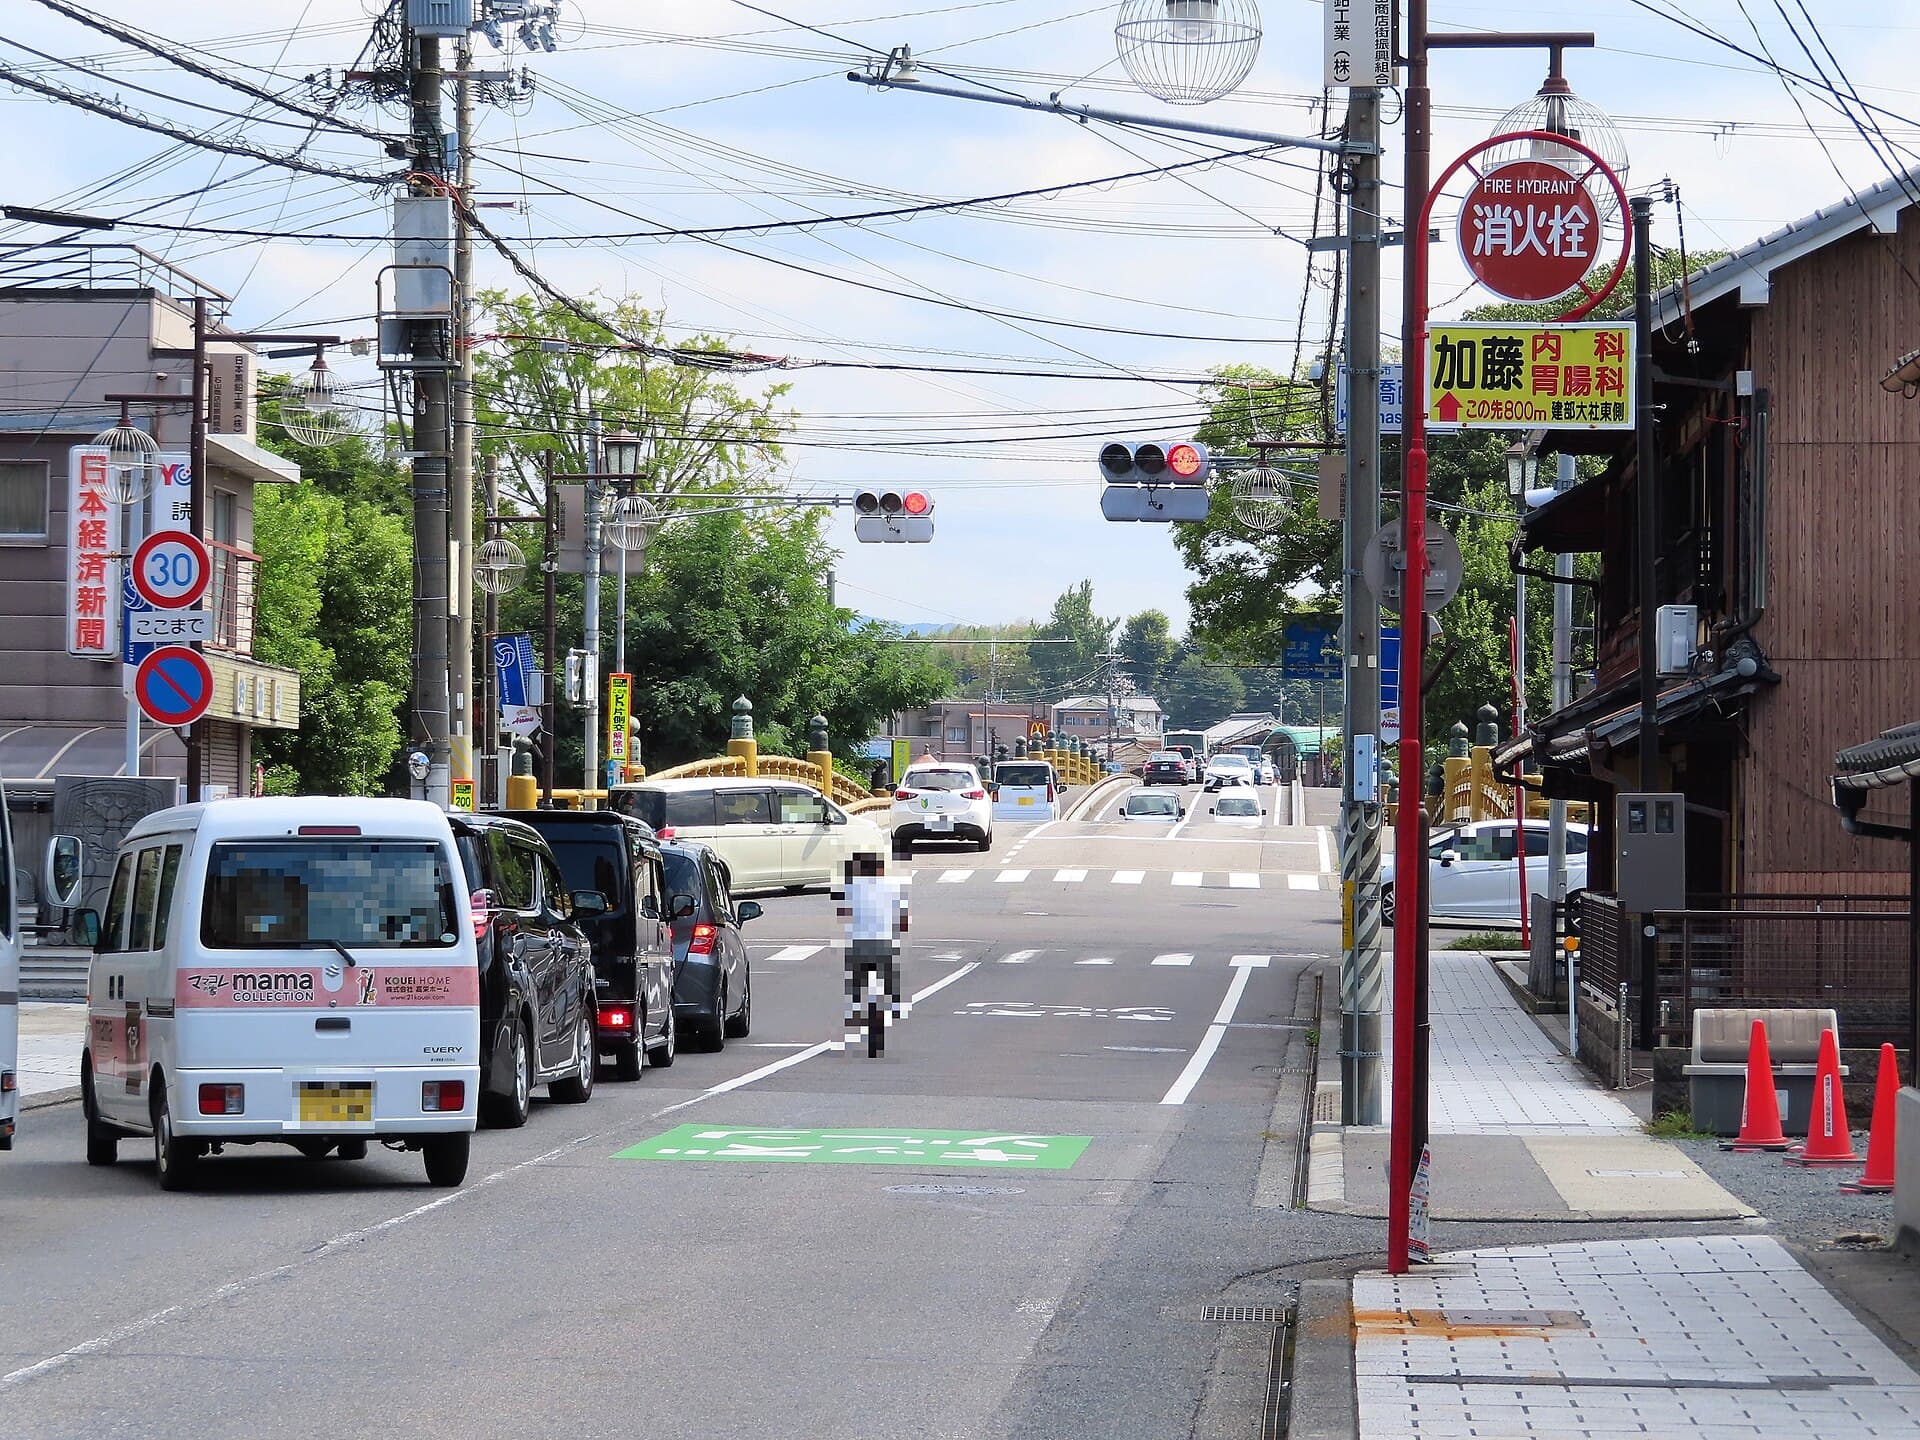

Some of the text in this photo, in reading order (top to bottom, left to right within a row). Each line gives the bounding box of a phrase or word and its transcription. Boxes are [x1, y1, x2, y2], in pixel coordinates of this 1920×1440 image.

[1375, 0, 1389, 84] 商店街振興組合
[1484, 180, 1576, 194] FIRE HYDRANT
[1472, 204, 1590, 257] 消火栓
[1433, 335, 1524, 391] 加藤
[1532, 365, 1624, 397] 胃腸科
[1466, 400, 1547, 421] この先800m
[1551, 401, 1624, 421] 建部大社東側
[77, 455, 108, 650] 日本経済新聞
[150, 553, 192, 587] 30
[137, 618, 204, 636] ここまで
[455, 796, 471, 807] 200
[232, 973, 314, 990] mama
[385, 976, 451, 985] KOUEI HOME
[232, 992, 314, 1001] COLLECTION
[423, 1046, 463, 1054] EVERY
